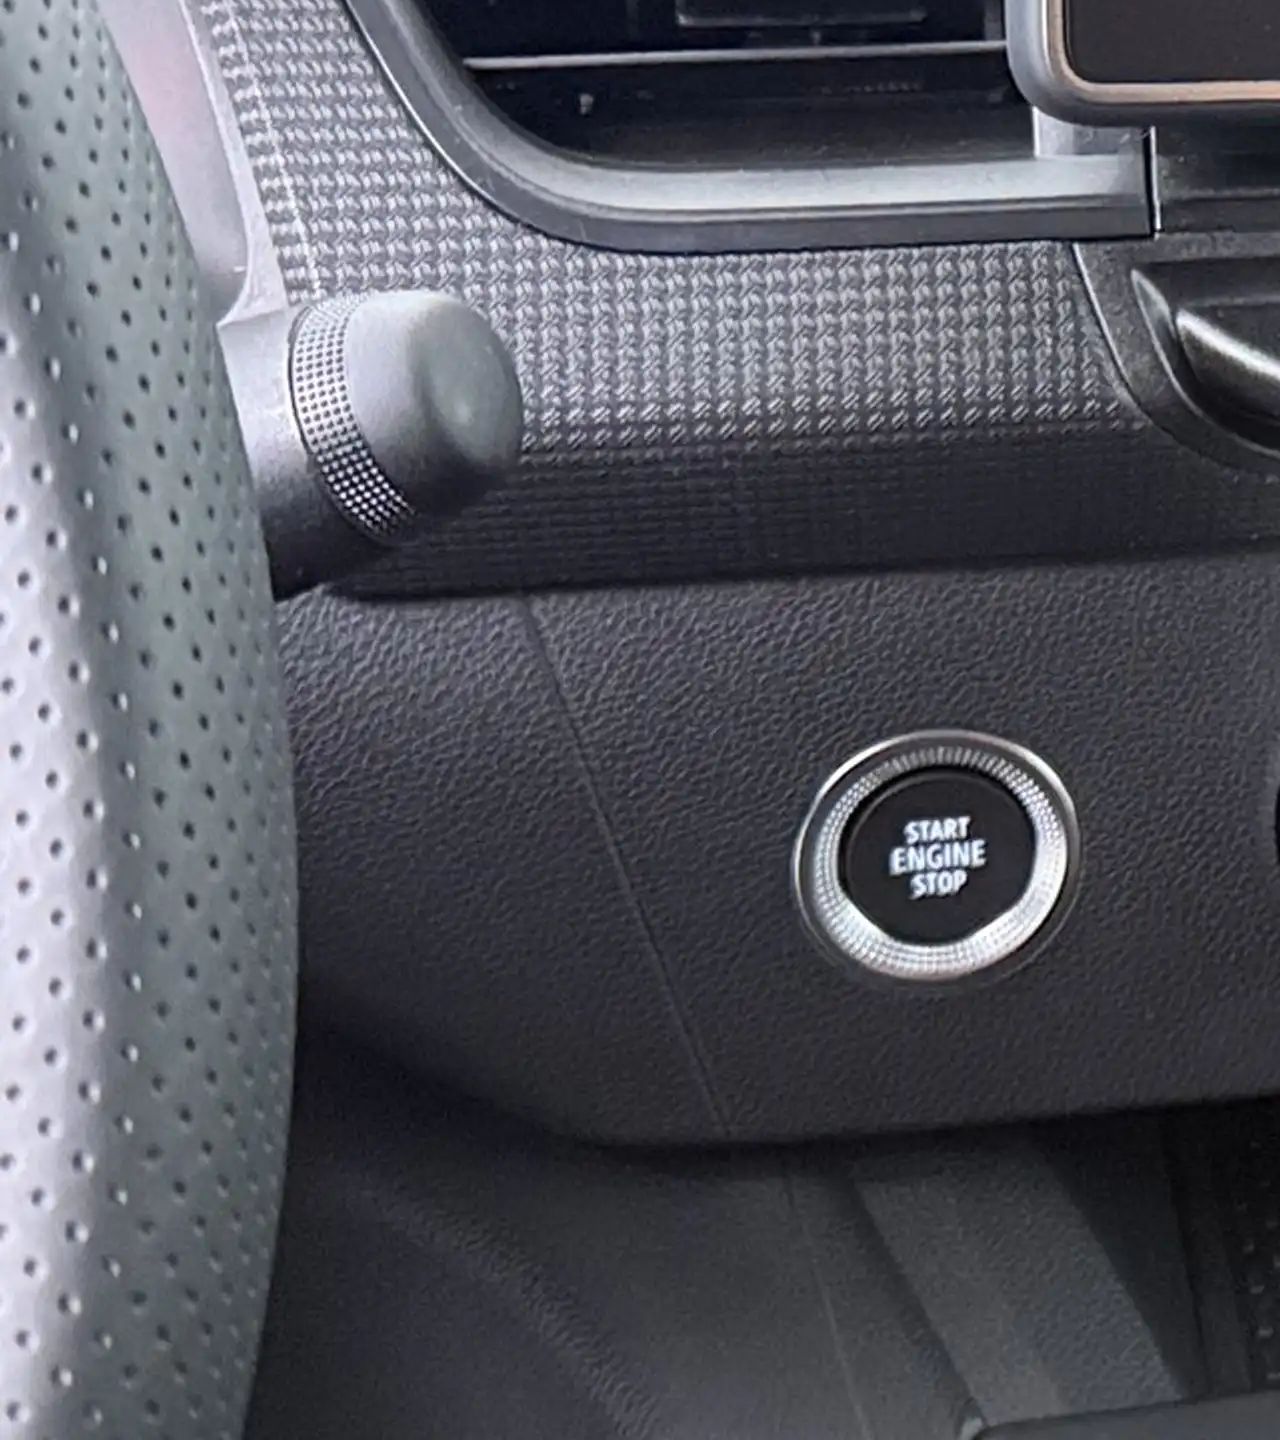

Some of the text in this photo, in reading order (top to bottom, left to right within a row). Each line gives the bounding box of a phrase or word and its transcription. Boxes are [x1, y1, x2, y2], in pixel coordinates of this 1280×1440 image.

[904, 816, 970, 844] START
[889, 839, 987, 875] ENGINE
[909, 870, 966, 899] STOP
